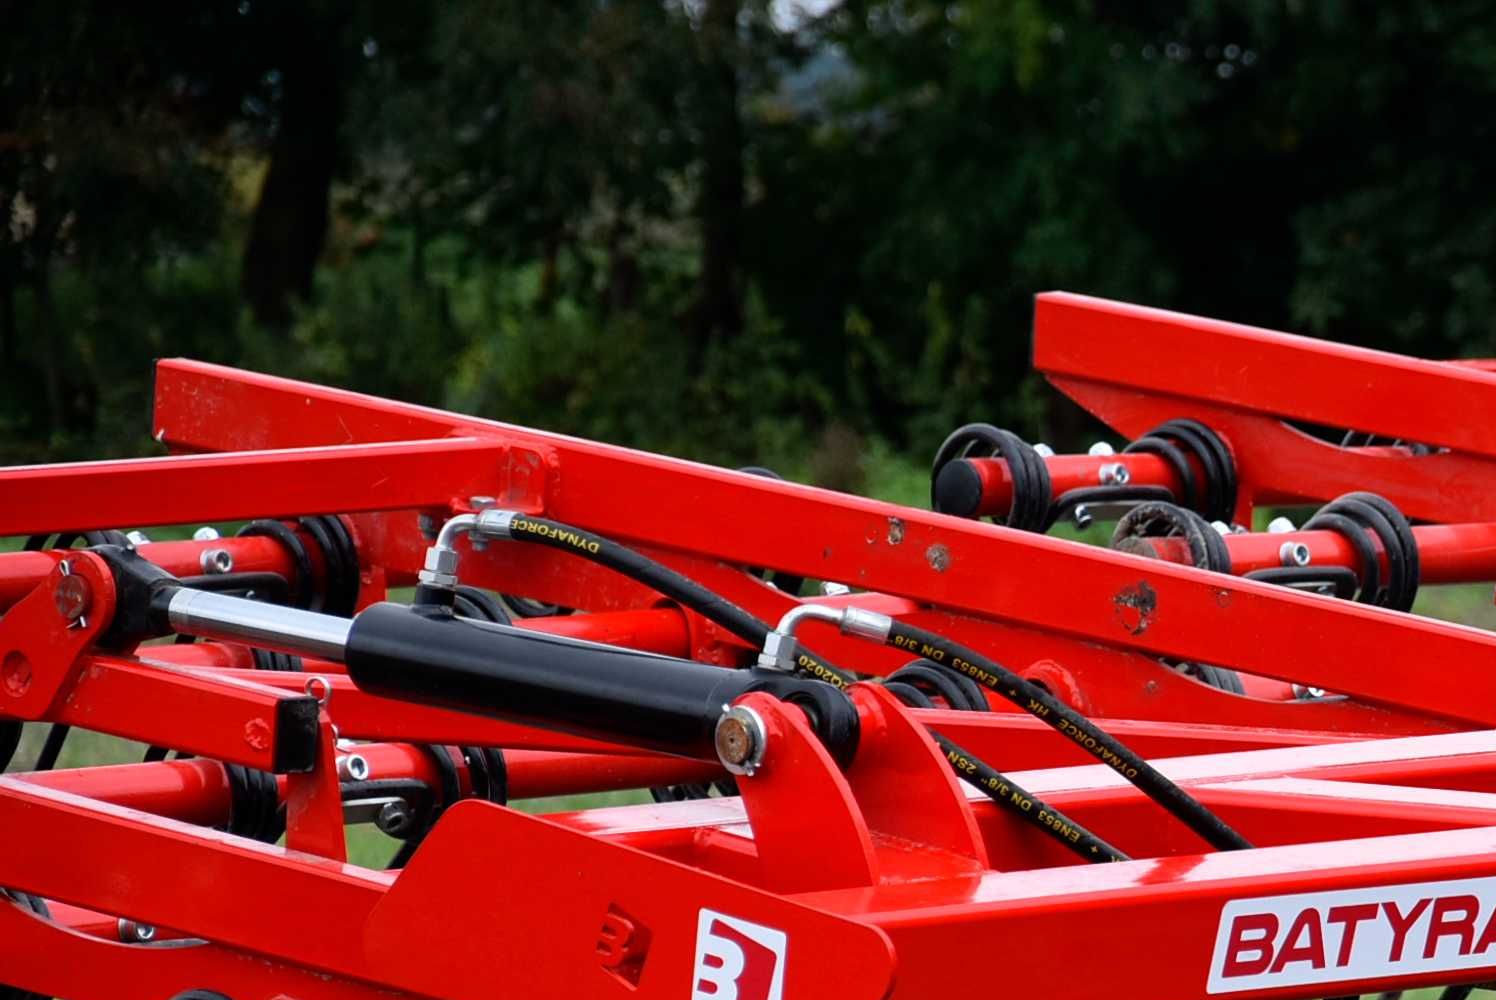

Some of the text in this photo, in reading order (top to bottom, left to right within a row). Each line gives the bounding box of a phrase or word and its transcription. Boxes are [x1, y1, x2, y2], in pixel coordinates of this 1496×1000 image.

[511, 519, 600, 554] DYNAFORCE
[921, 644, 945, 662] DN
[952, 657, 999, 688] EN853
[1027, 698, 1050, 717] HK
[1058, 717, 1139, 779] DYNAFORCE
[947, 751, 977, 775] 2SN
[1010, 792, 1033, 812] DN
[1037, 810, 1081, 843] EN853
